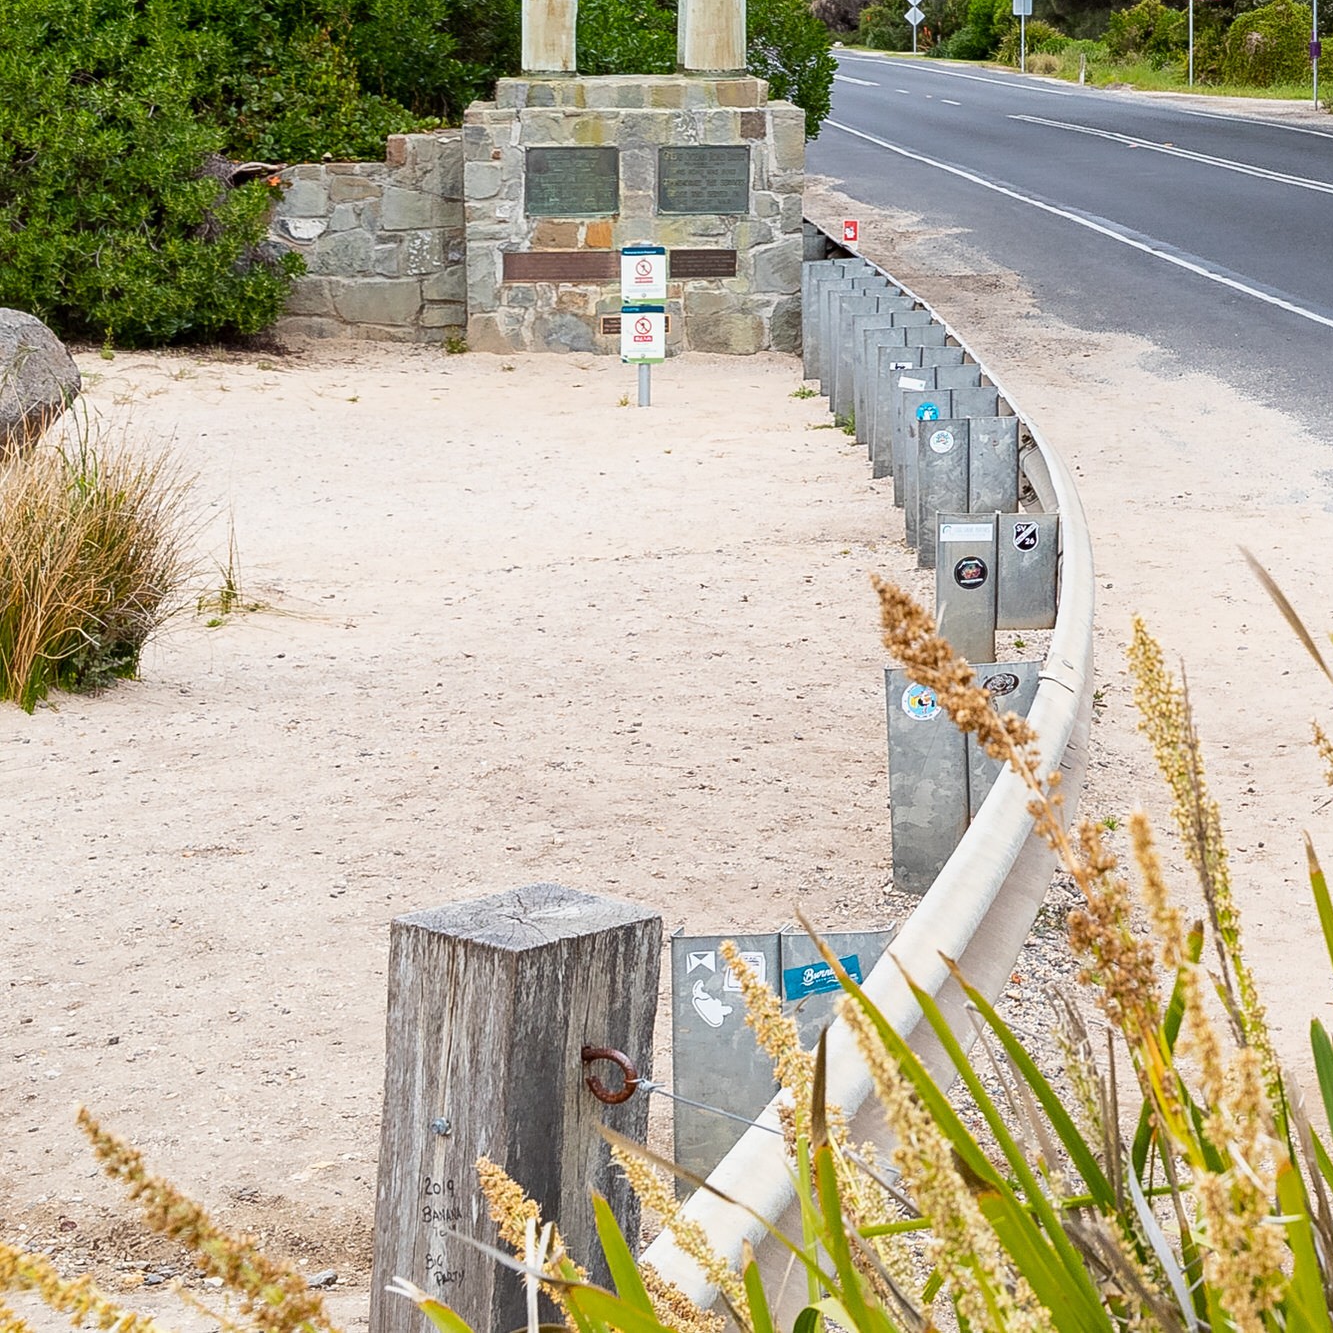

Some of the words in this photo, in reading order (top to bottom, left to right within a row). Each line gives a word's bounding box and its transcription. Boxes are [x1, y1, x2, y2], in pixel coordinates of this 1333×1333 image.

[1024, 537, 1035, 545] 26
[425, 1177, 454, 1197] 2019
[433, 1270, 465, 1288] PARTY
